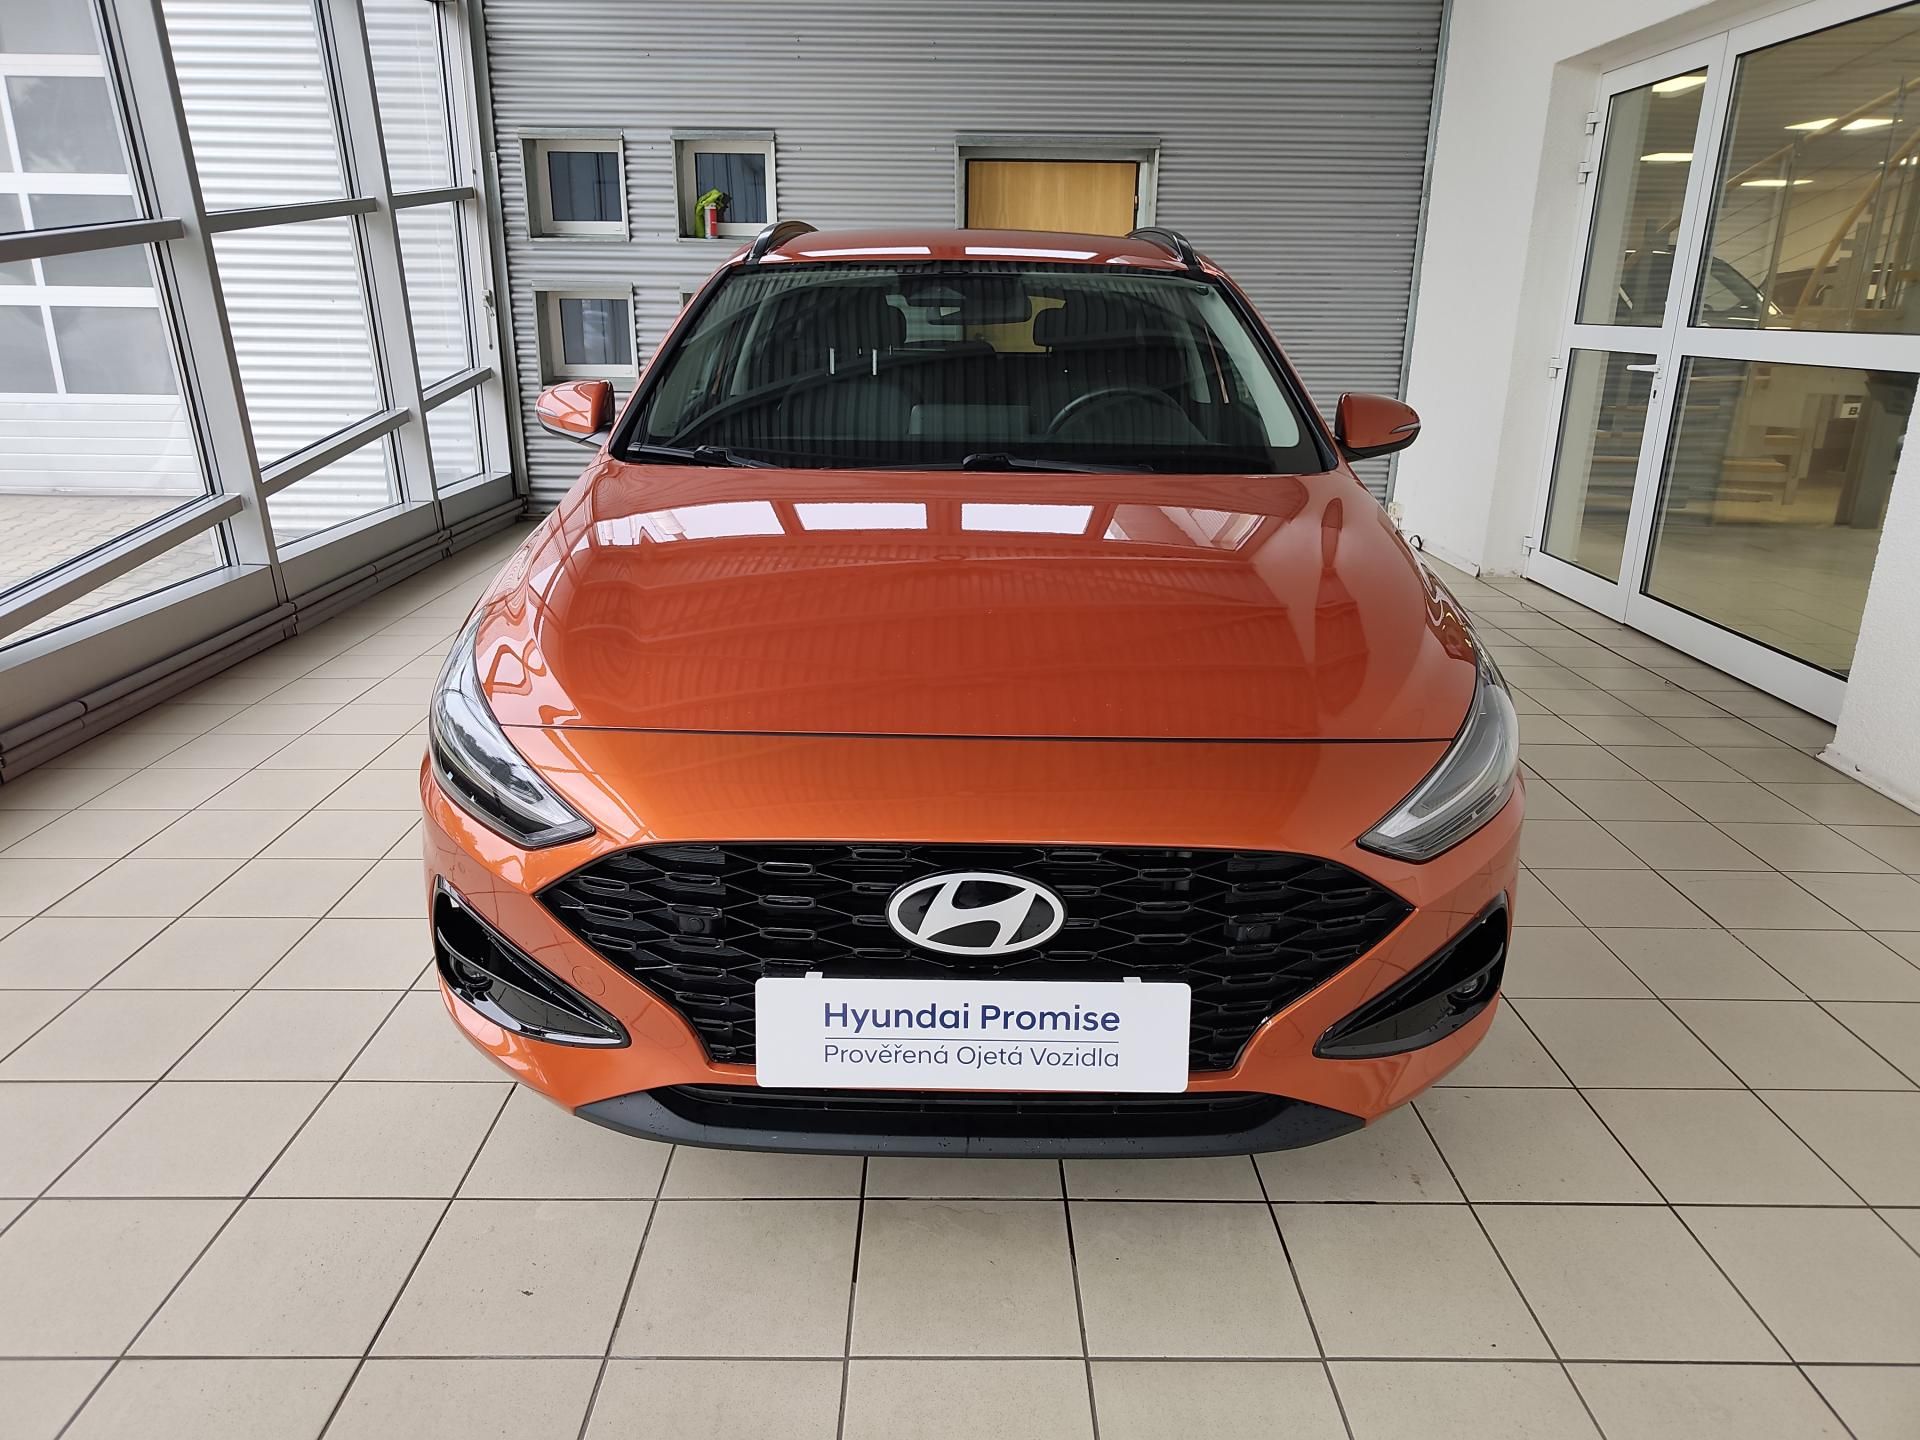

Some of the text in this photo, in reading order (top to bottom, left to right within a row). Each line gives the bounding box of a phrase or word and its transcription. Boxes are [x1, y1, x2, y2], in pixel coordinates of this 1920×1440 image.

[824, 1002, 1121, 1034] Hyundai Promise
[824, 1043, 1120, 1070] Prověřená Ojetá Vozidla
